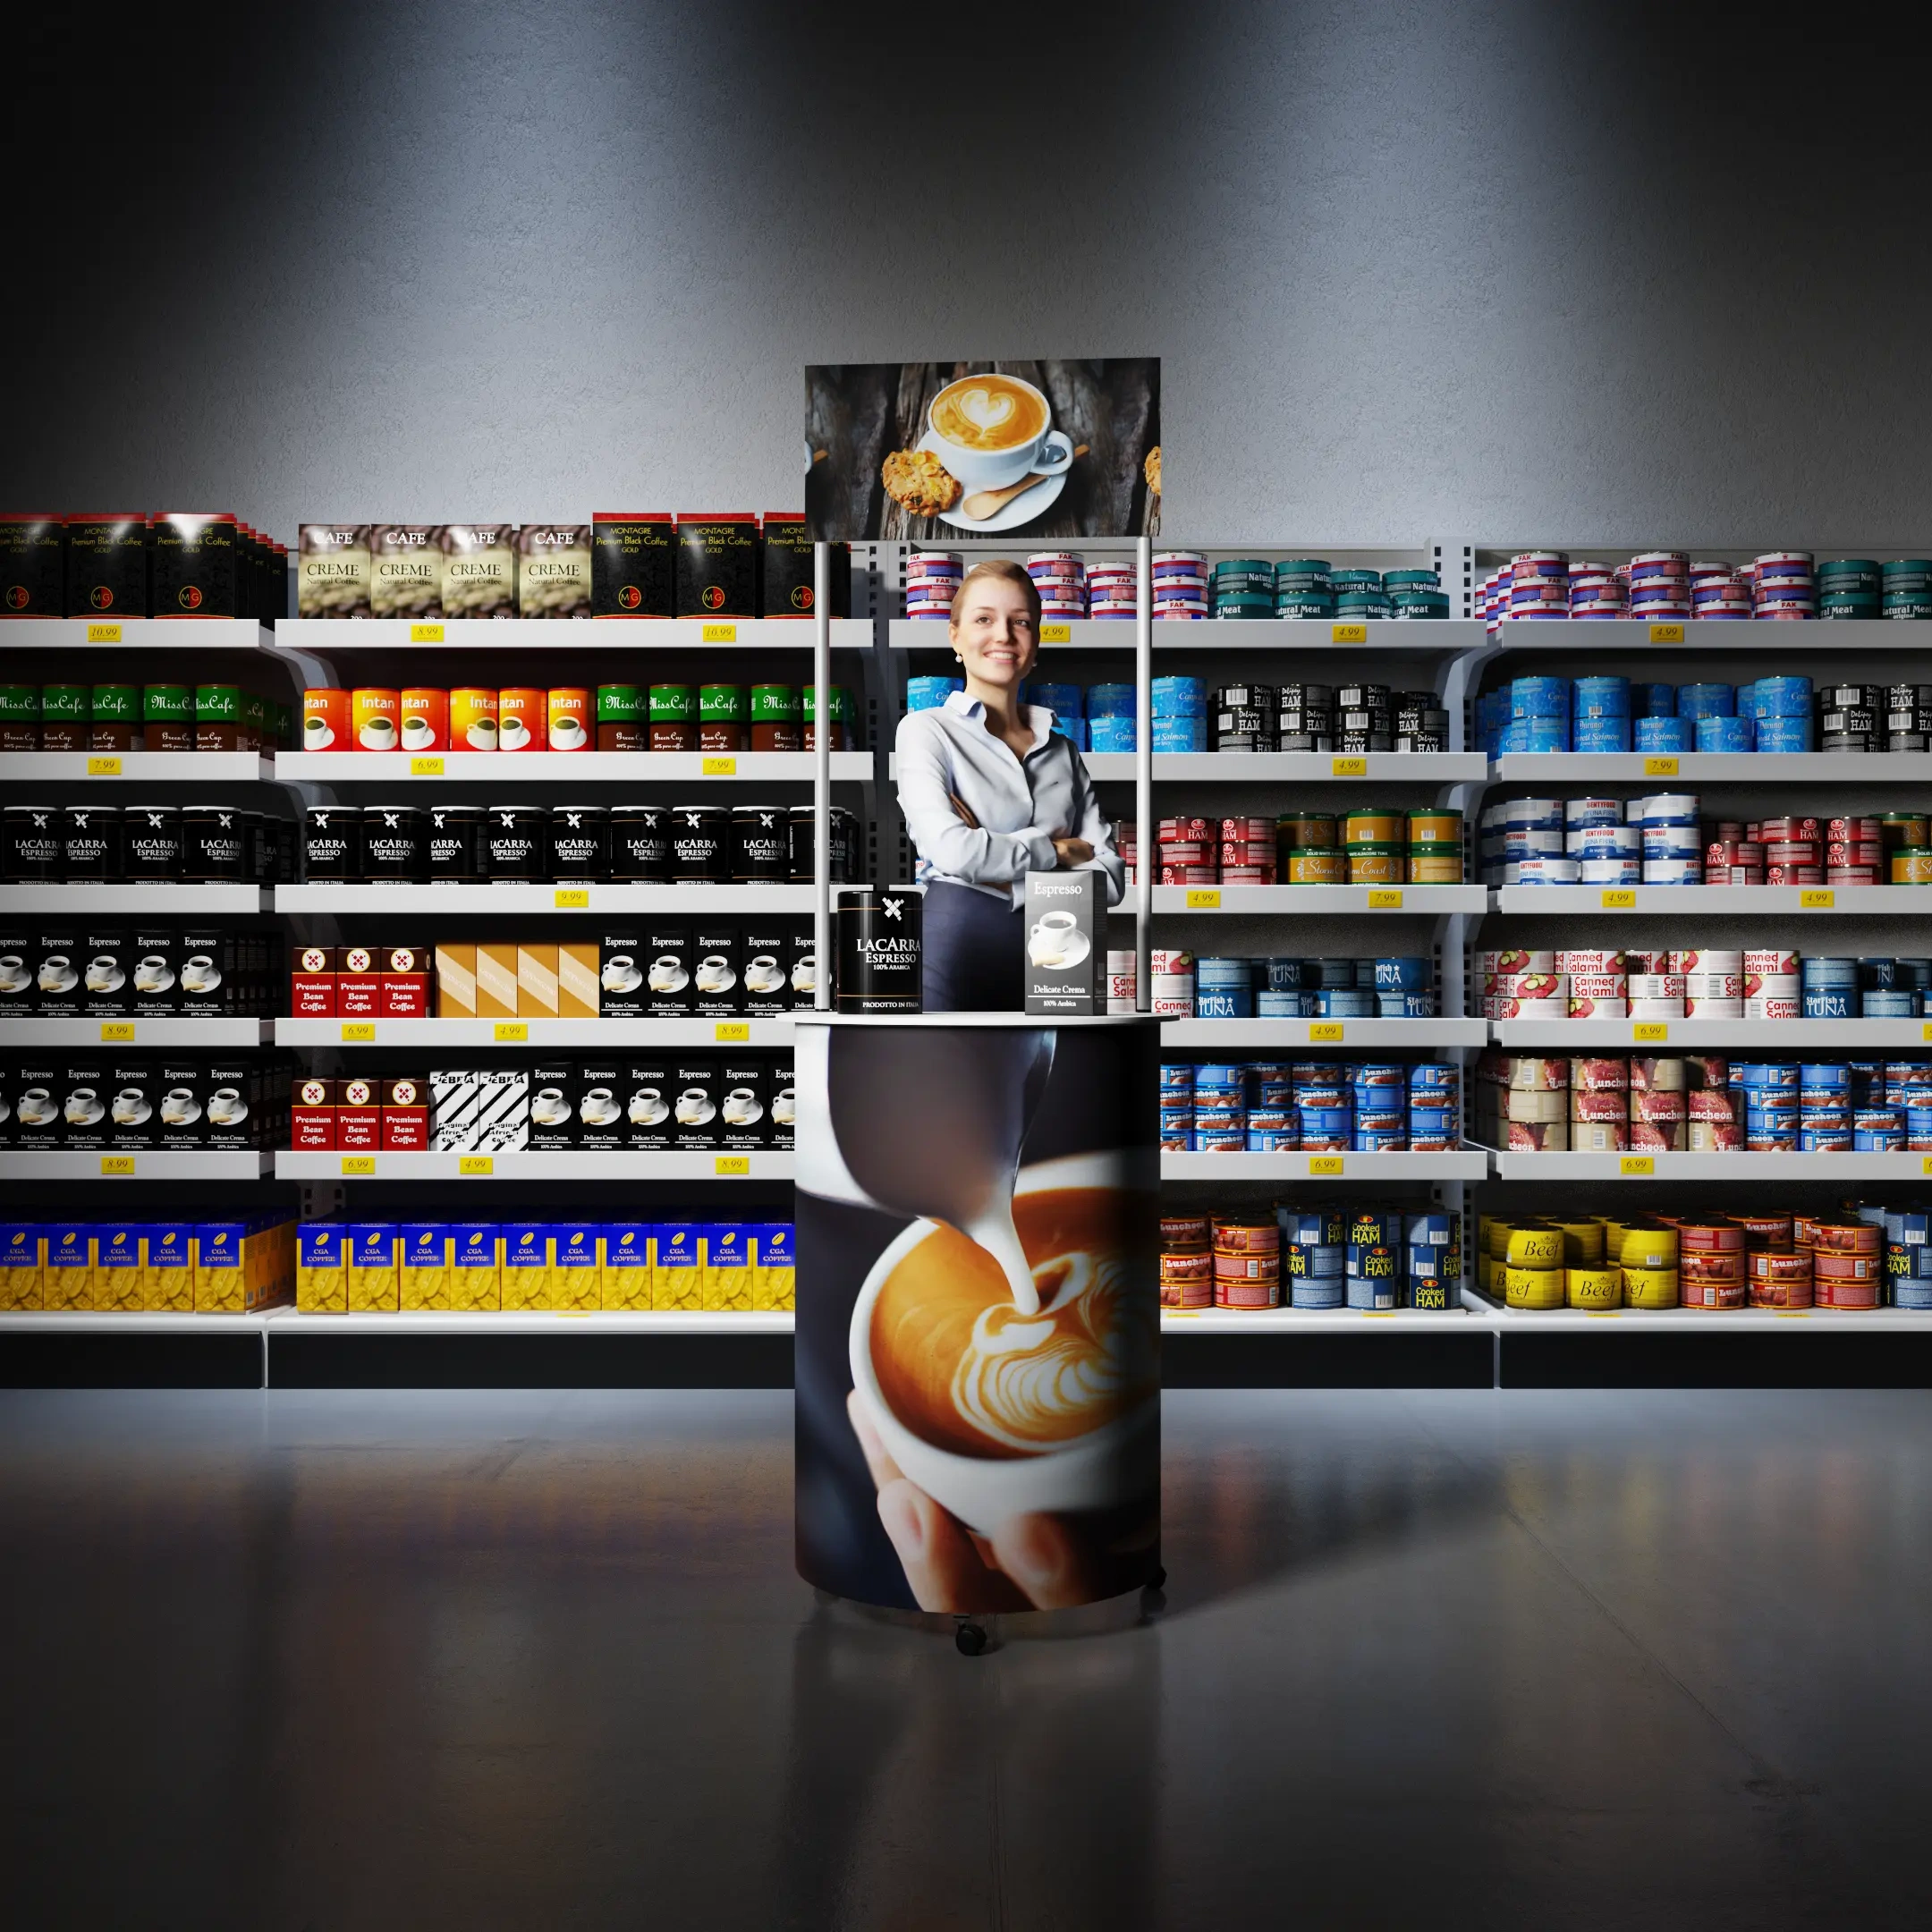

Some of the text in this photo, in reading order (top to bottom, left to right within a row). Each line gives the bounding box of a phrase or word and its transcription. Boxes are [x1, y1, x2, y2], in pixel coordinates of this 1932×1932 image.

[157, 537, 231, 547] Premium Coffee
[313, 533, 352, 545] CAFE
[386, 533, 426, 545] CAFE
[535, 533, 573, 544] CAFE
[597, 538, 622, 546] Premium
[644, 537, 668, 546] Coffee
[728, 537, 751, 546] Coffee
[307, 564, 359, 576] CREME
[380, 564, 432, 576] CREME
[529, 564, 580, 576] CREME
[555, 578, 580, 586] Coffee
[1301, 606, 1320, 614] Meat
[1408, 605, 1428, 614] Meat
[1832, 606, 1853, 614] Meat
[91, 628, 117, 638] 10.99
[418, 627, 438, 636] 8.99
[707, 628, 731, 637] 10.99
[1043, 628, 1063, 637] 4.99
[1339, 627, 1360, 636] 4.99
[1657, 628, 1677, 636] 4.99
[362, 697, 394, 709] intan
[551, 697, 580, 708] intan
[1282, 696, 1301, 708] HAM
[1891, 697, 1913, 708] HAM
[1239, 720, 1260, 731] HAM
[1592, 733, 1620, 741] Salmon
[1653, 733, 1681, 741] Salmon
[95, 760, 114, 768] 7.99
[418, 760, 437, 769] 6.99
[709, 760, 729, 768] 7.99
[1339, 761, 1360, 769] 4.99
[1652, 761, 1672, 769] 7.99
[1188, 831, 1208, 839] HAM
[1828, 831, 1847, 840] HAM
[555, 839, 598, 849] LACARRA
[674, 839, 717, 849] LACARRA
[1707, 854, 1725, 864] HAM
[1360, 857, 1386, 875] Coast
[1034, 882, 1082, 897] Espresso
[1375, 894, 1395, 902] 7.99
[1608, 894, 1628, 902] 4.99
[1807, 894, 1826, 902] 4.99
[184, 937, 216, 946] Espresso
[605, 937, 637, 947] Espresso
[857, 937, 920, 952] LACARRA
[865, 953, 916, 963] ESPRESSO
[1574, 977, 1614, 986] Canned
[295, 983, 331, 991] Premium
[385, 983, 420, 991] Premium
[1034, 985, 1085, 994] Delicate Crema
[1575, 987, 1614, 996] Salami
[301, 1002, 326, 1012] Coffee
[389, 1002, 415, 1012] Coffee
[1199, 1004, 1234, 1015] TUNA
[1806, 1004, 1846, 1015] TUNA
[107, 1026, 128, 1035] 8.99
[348, 1026, 369, 1036] 6.99
[500, 1027, 521, 1036] 4.99
[722, 1027, 741, 1035] 8.99
[1316, 1027, 1336, 1035] 4.99
[1640, 1027, 1661, 1035] 6.99
[165, 1070, 197, 1080] Espresso
[726, 1070, 758, 1079] Espresso
[344, 1136, 370, 1145] Coffee
[107, 1159, 128, 1168] 8.99
[348, 1160, 369, 1169] 6.99
[466, 1160, 486, 1169] 4.99
[722, 1160, 742, 1168] 8.99
[1315, 1161, 1335, 1169] 6.99
[1626, 1160, 1646, 1168] 6.99
[1352, 1224, 1379, 1233] Cooked
[1352, 1233, 1380, 1243] HAM
[1524, 1240, 1561, 1259] Beef
[1416, 1287, 1445, 1296] Cooked
[1580, 1280, 1617, 1300] Beef
[1416, 1296, 1445, 1308] HAM
